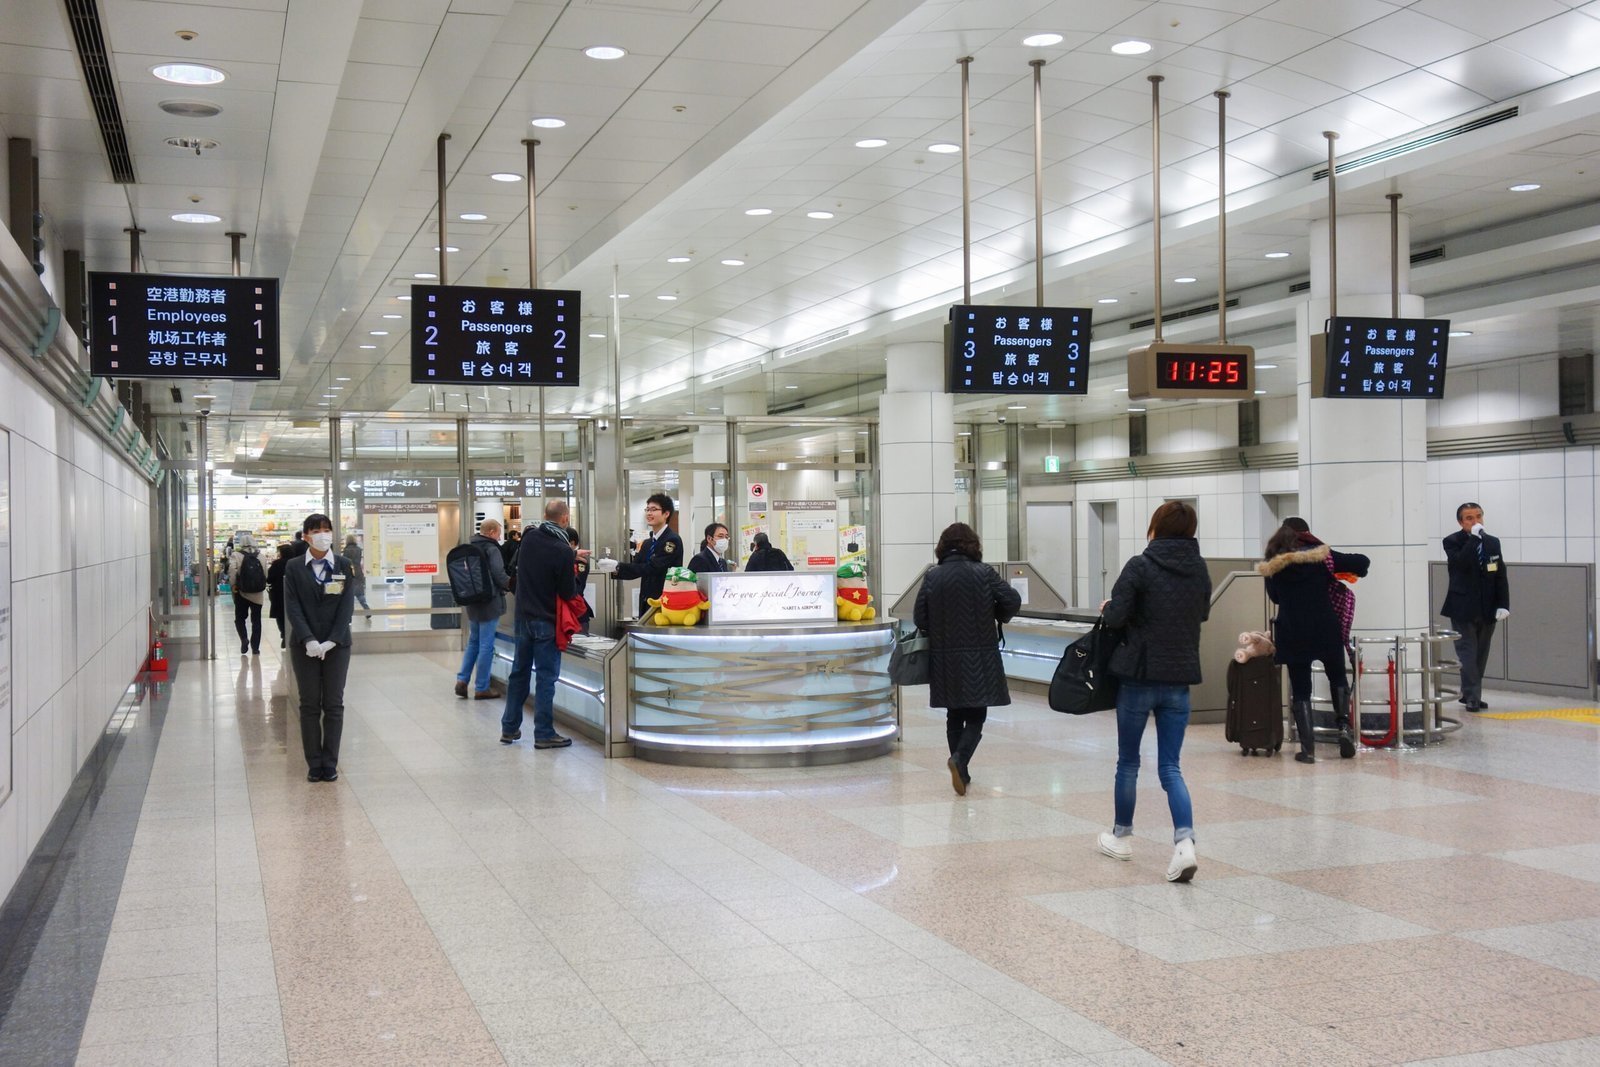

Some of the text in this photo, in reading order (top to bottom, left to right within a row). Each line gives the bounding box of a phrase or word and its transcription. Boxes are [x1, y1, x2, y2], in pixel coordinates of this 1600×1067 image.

[146, 287, 227, 304] 空港勤務者
[147, 308, 227, 325] Employees
[108, 315, 117, 336] 1
[253, 319, 262, 339] 1
[461, 319, 533, 336] Passengers
[148, 330, 227, 347] 机场工作者
[424, 325, 439, 346] 2
[553, 329, 567, 349] 2
[993, 334, 1053, 349] Passengers
[963, 340, 976, 359] 3
[1067, 342, 1080, 361] 3
[1365, 345, 1415, 358] Passengers
[148, 351, 227, 367] 공항 근무자
[1340, 350, 1350, 367] 4
[1428, 352, 1438, 368] 4
[1170, 361, 1239, 383] 11:25
[722, 582, 823, 607] For your special Journey
